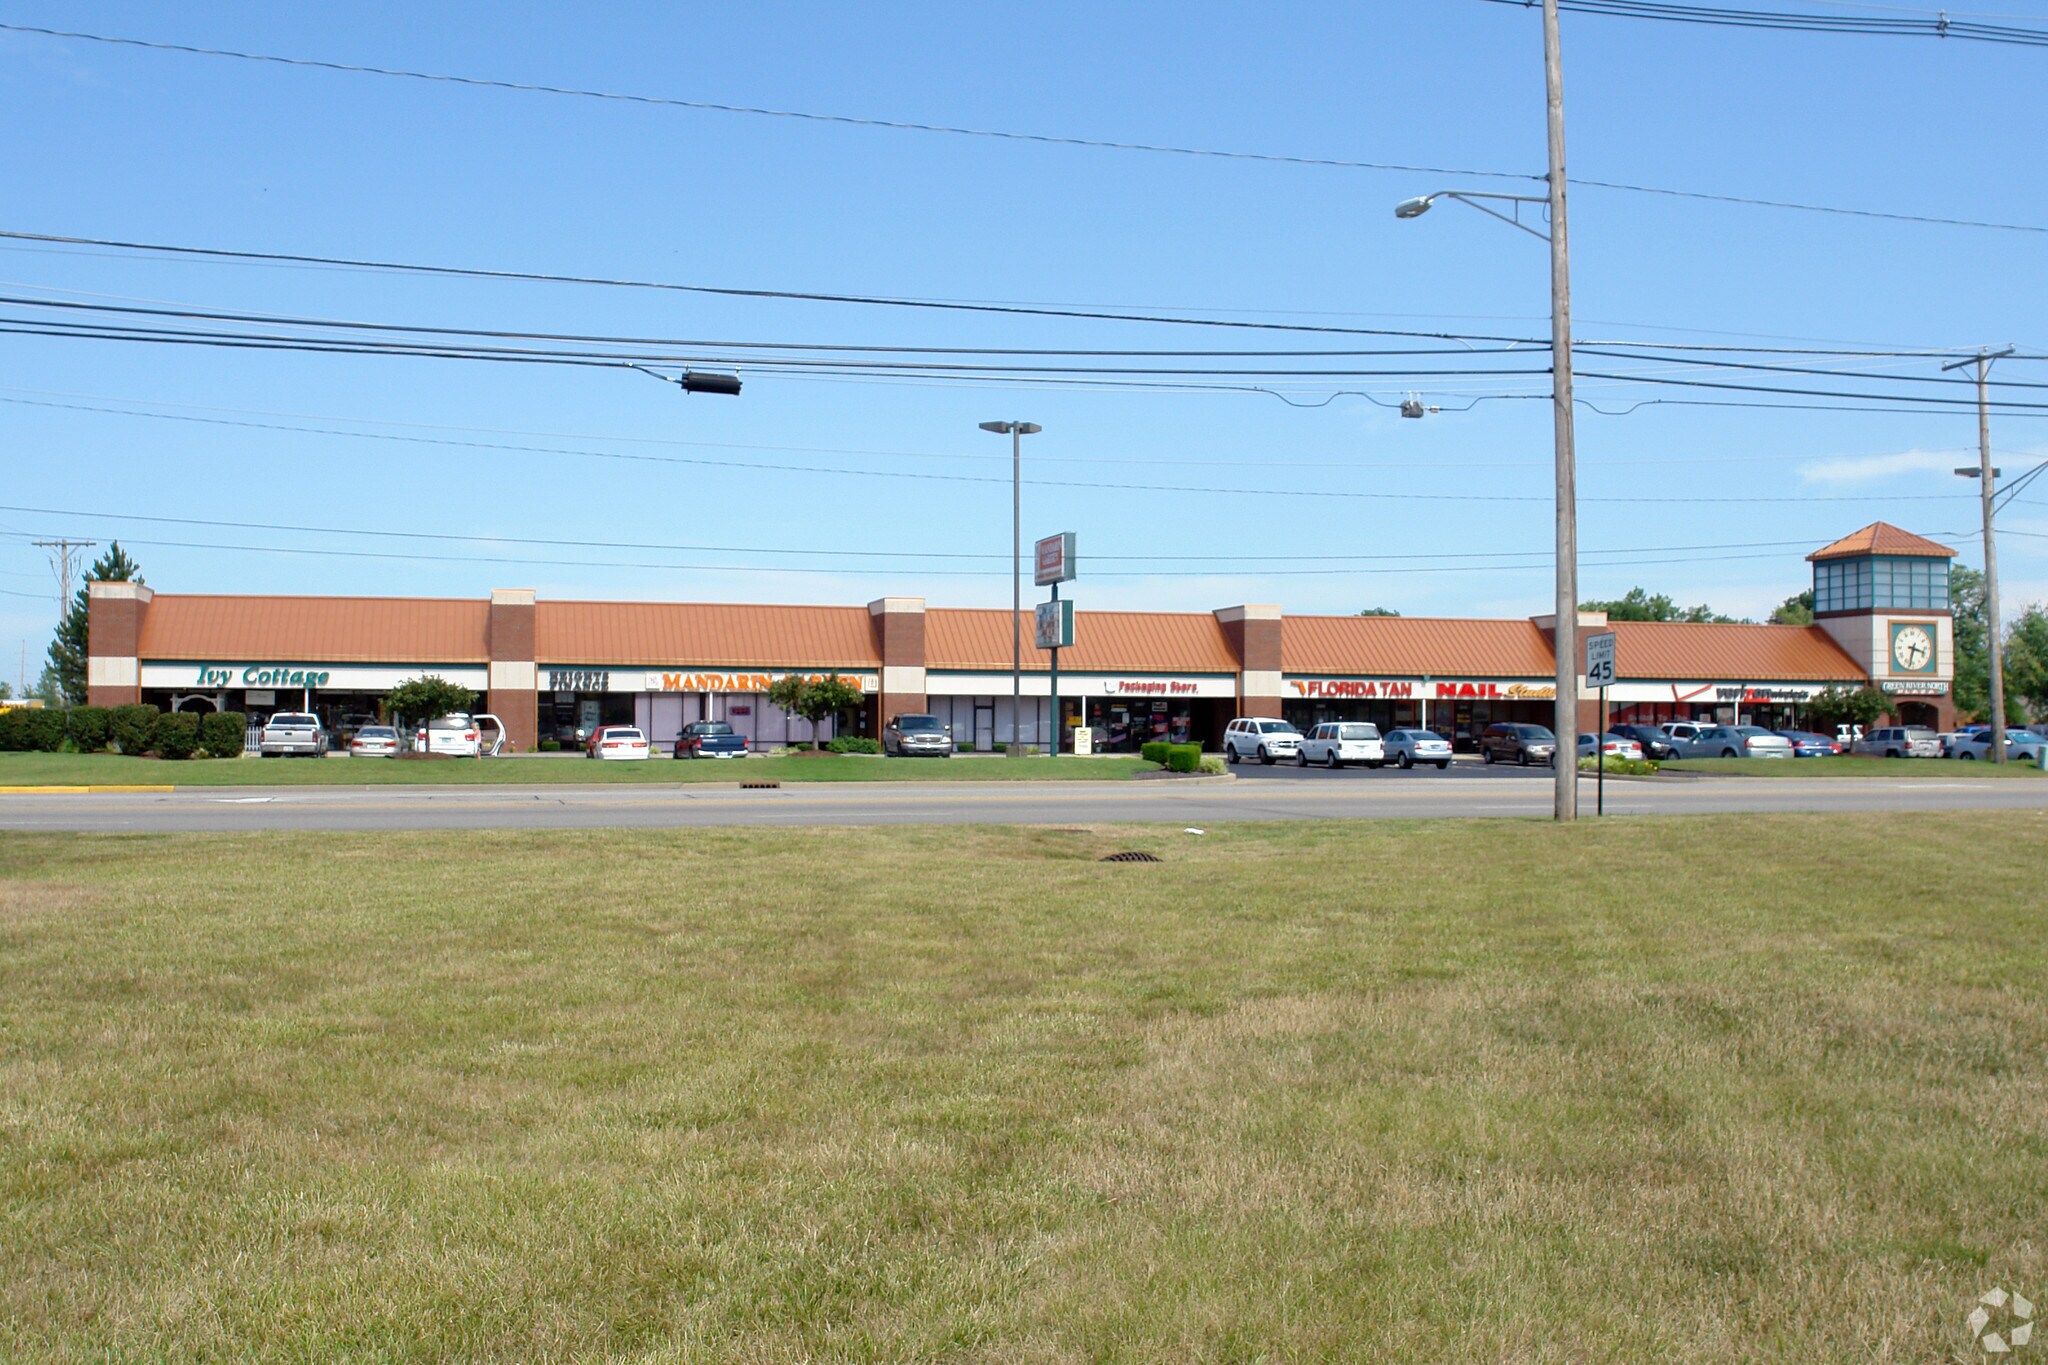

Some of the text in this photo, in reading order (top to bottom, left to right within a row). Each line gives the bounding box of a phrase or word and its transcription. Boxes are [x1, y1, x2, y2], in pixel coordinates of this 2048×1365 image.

[1589, 639, 1613, 650] SPEED
[1591, 650, 1610, 660] LIMIT
[197, 665, 330, 688] Ivy Cottage
[1589, 660, 1612, 680] 45
[662, 673, 771, 690] MANDARIN
[1119, 681, 1167, 694] Packaging
[1883, 682, 1949, 691] GREEN RIVER NORTH
[1308, 681, 1412, 697] FLORIDA TAN
[1436, 683, 1502, 697] NAIL
